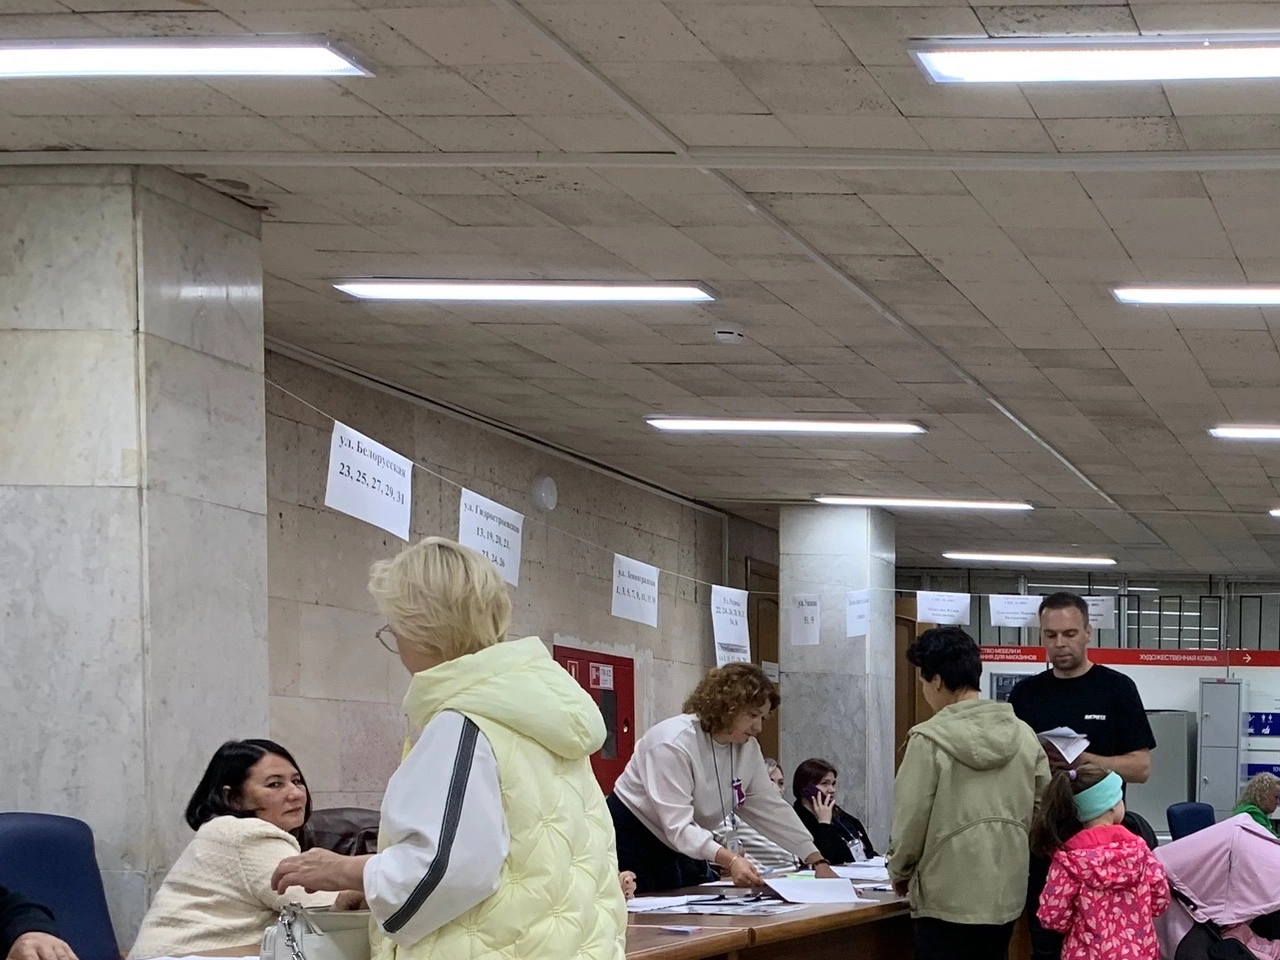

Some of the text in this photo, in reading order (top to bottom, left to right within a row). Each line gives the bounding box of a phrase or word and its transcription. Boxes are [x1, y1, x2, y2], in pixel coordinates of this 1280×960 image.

[339, 435, 406, 478] ул. Белорусская
[339, 462, 405, 505] 23, 25, 27, 29, 31
